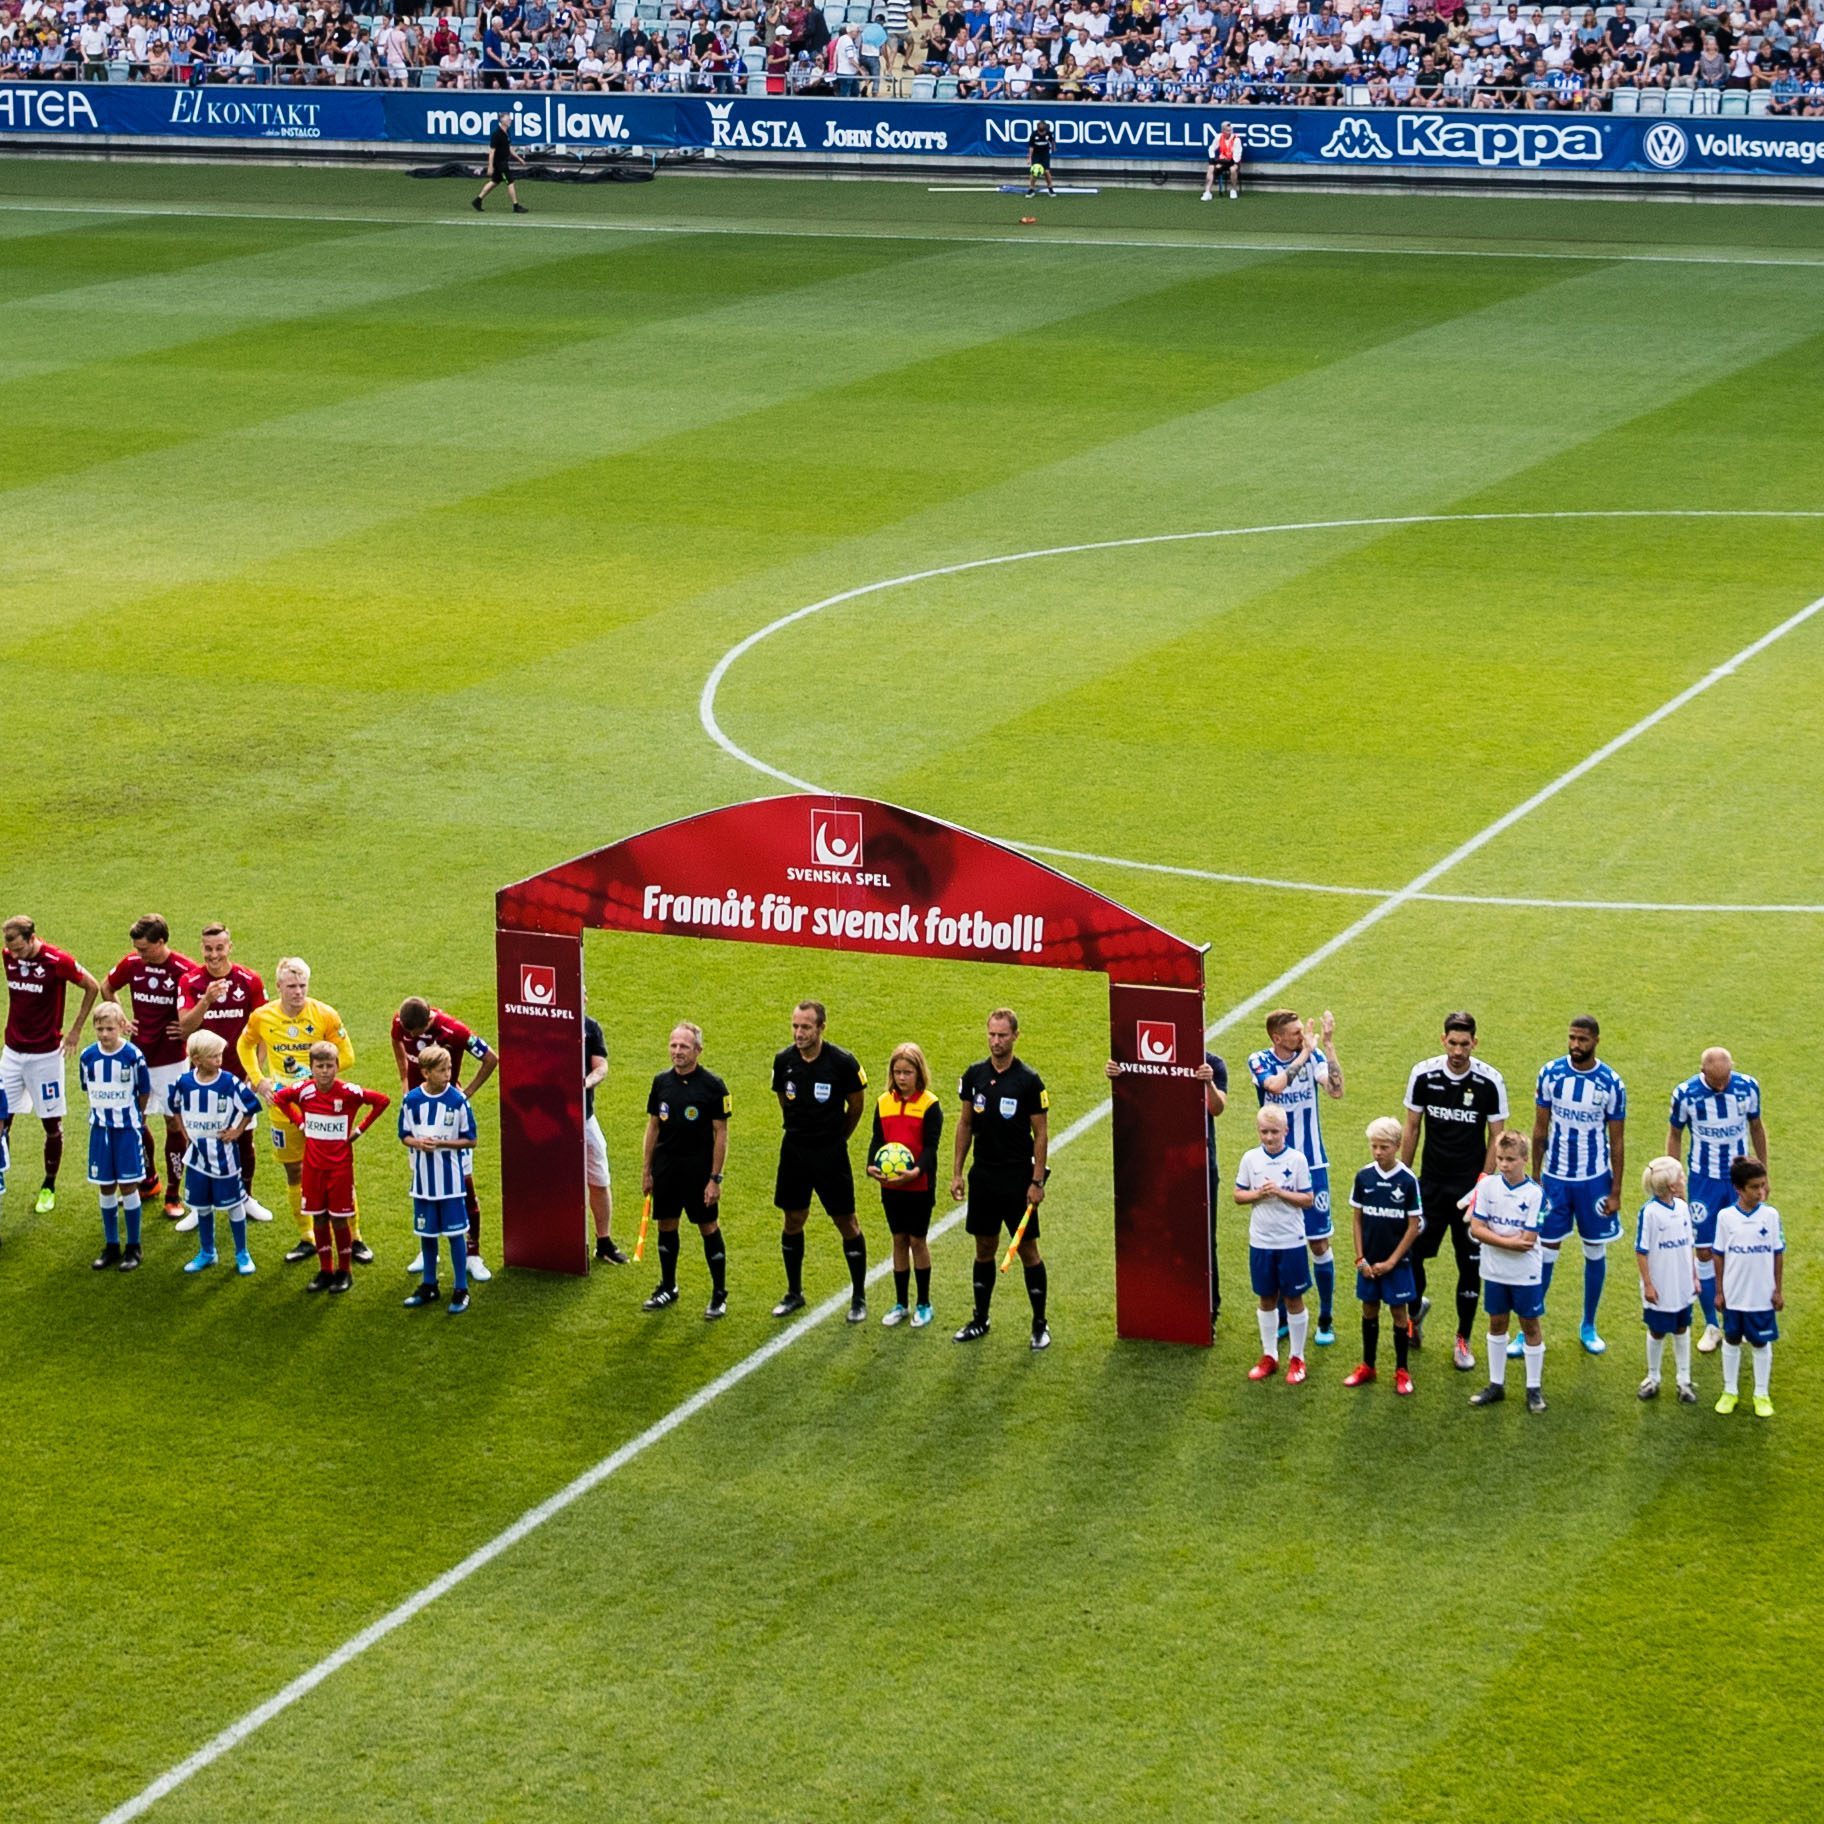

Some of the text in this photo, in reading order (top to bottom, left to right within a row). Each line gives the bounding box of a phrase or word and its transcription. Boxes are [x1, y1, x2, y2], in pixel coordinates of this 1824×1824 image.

[170, 90, 320, 126] El KONTAKT
[427, 99, 630, 139] moris law.
[281, 127, 321, 139] INSTALCO
[711, 120, 806, 148] RASTA
[1397, 115, 1603, 166] Kappa
[787, 867, 891, 888] SVENSKA SPEL
[643, 885, 1044, 954] Framåt för svensk fotboll!
[8, 981, 43, 993] HOLMEN
[133, 993, 174, 1005] HOLMEN
[504, 1003, 575, 1020] SVENSKA SPEL
[1119, 1062, 1198, 1079] SVENSKA SPEL
[1265, 1087, 1313, 1104] SERNEKE
[1427, 1104, 1476, 1123] SERNEKE
[1553, 1107, 1602, 1123] SERNEKE
[306, 1121, 345, 1132] SERNEKE
[1697, 1125, 1744, 1138] SERNEKE
[1363, 1205, 1405, 1218] HOLMEN
[1658, 1239, 1688, 1250] HOLM
[1728, 1245, 1772, 1254] HOLMEN
